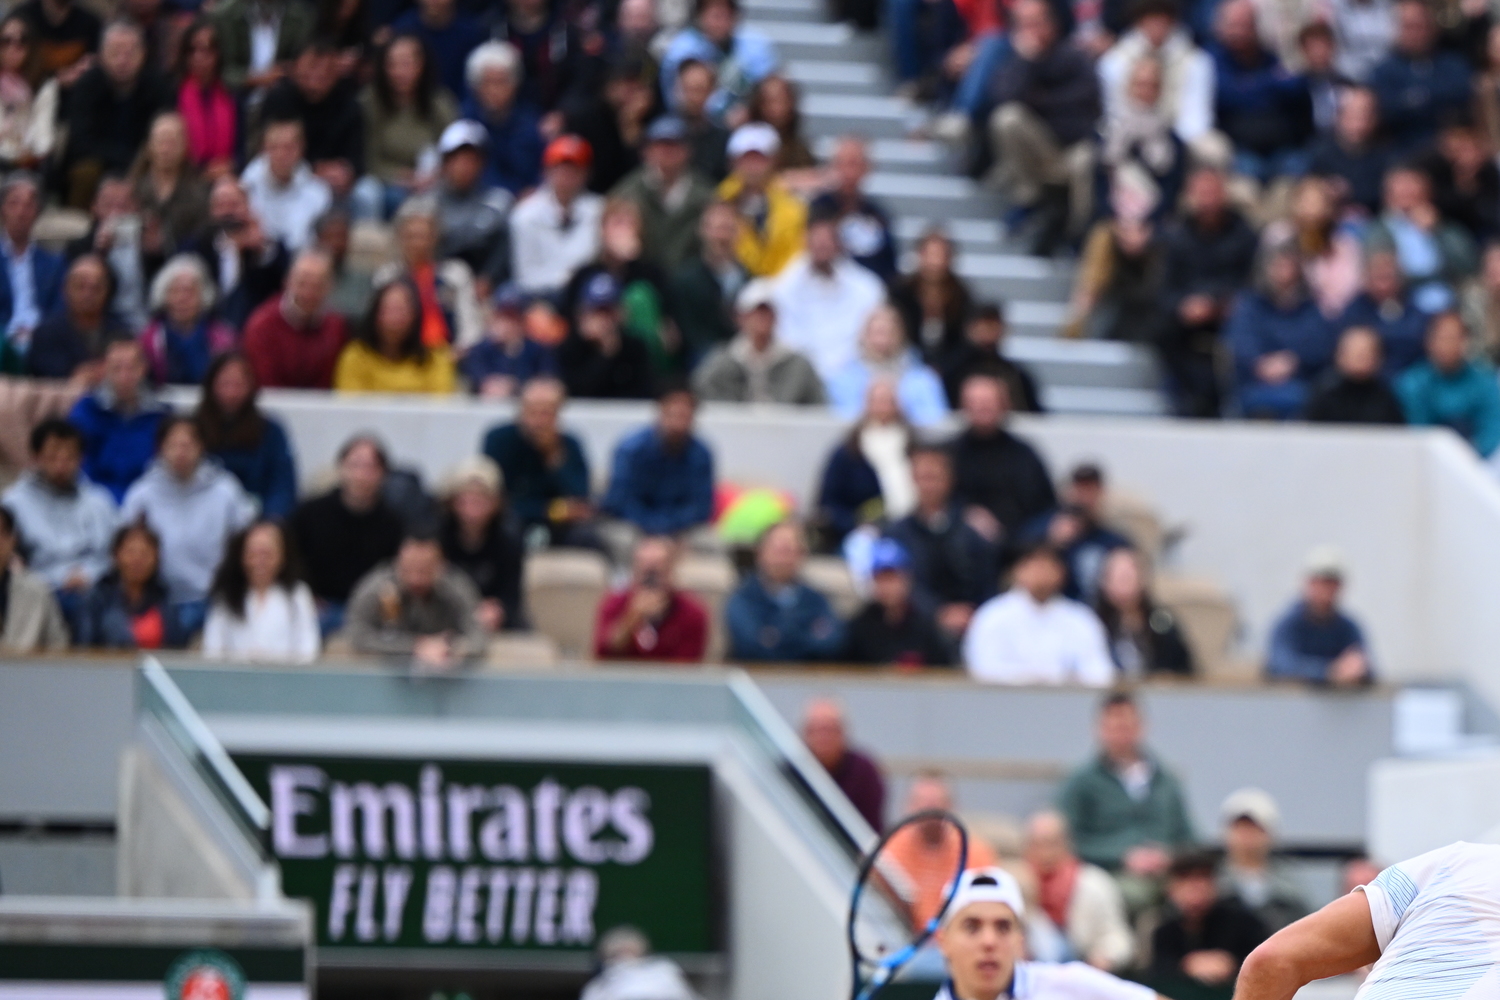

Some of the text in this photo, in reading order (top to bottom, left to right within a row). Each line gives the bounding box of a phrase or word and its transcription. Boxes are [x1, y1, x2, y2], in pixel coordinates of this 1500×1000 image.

[268, 763, 656, 866] Emirates
[327, 865, 600, 946] FLY BETTER
